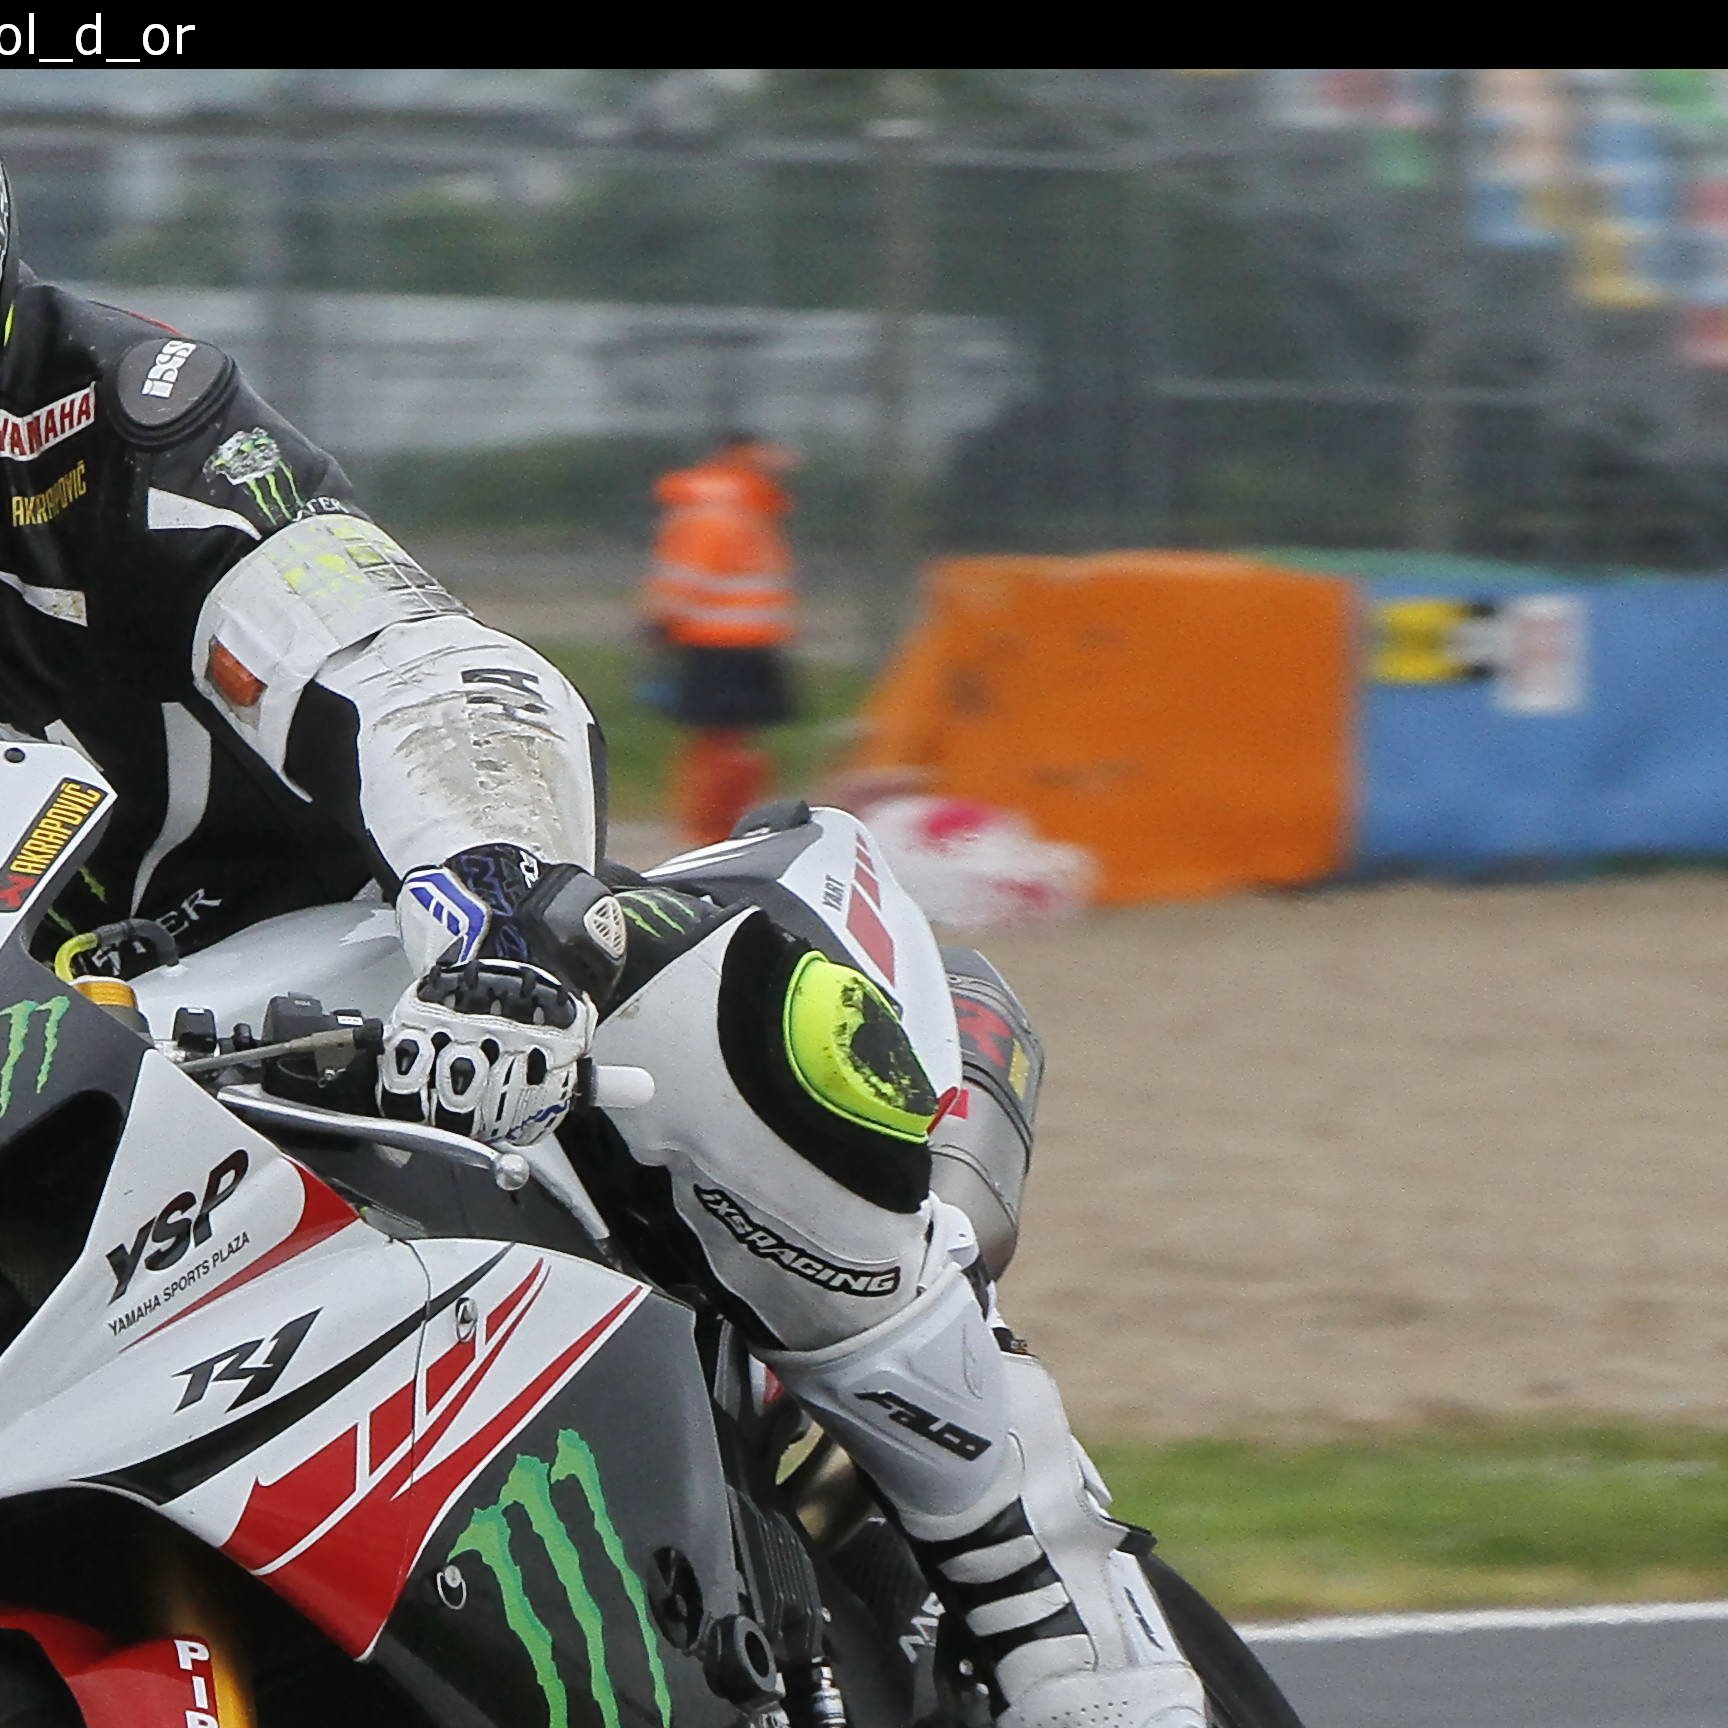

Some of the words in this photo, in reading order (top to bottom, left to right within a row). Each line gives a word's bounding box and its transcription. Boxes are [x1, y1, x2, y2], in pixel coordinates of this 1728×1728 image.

[105, 1148, 249, 1307] YSP
[107, 1294, 162, 1337] YAMAHA
[163, 1259, 211, 1303] SPORTS
[212, 1231, 251, 1269] PLAZA
